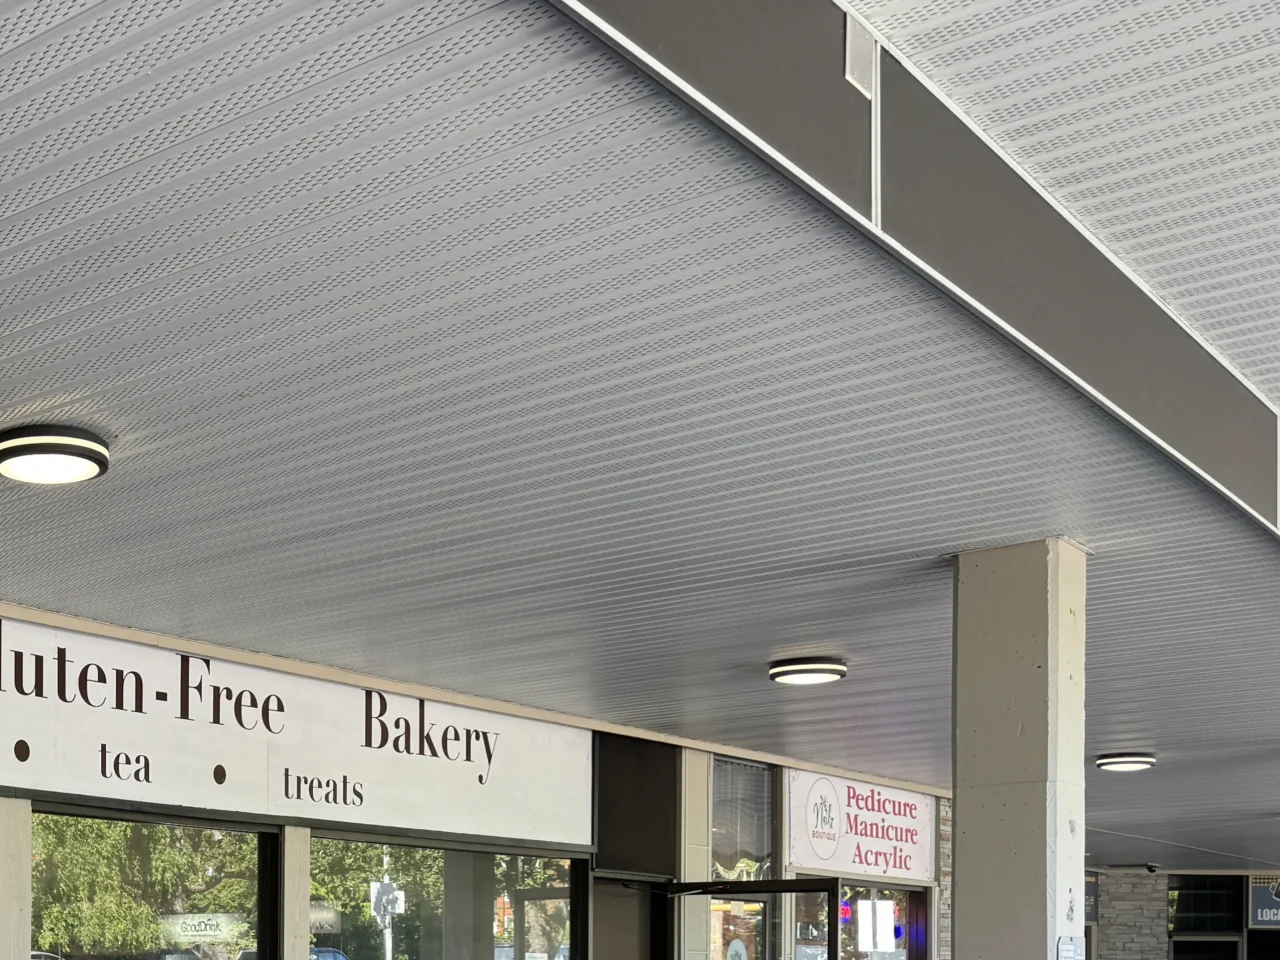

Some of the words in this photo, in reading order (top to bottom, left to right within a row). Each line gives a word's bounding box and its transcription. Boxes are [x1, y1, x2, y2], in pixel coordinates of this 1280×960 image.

[360, 689, 500, 785] Bakery
[99, 743, 152, 784] tea
[283, 767, 364, 807] treats
[846, 785, 917, 819] Pedicure
[812, 830, 836, 841] BOUTIQUE
[845, 812, 918, 845] Manicure
[852, 842, 912, 874] Acrylic
